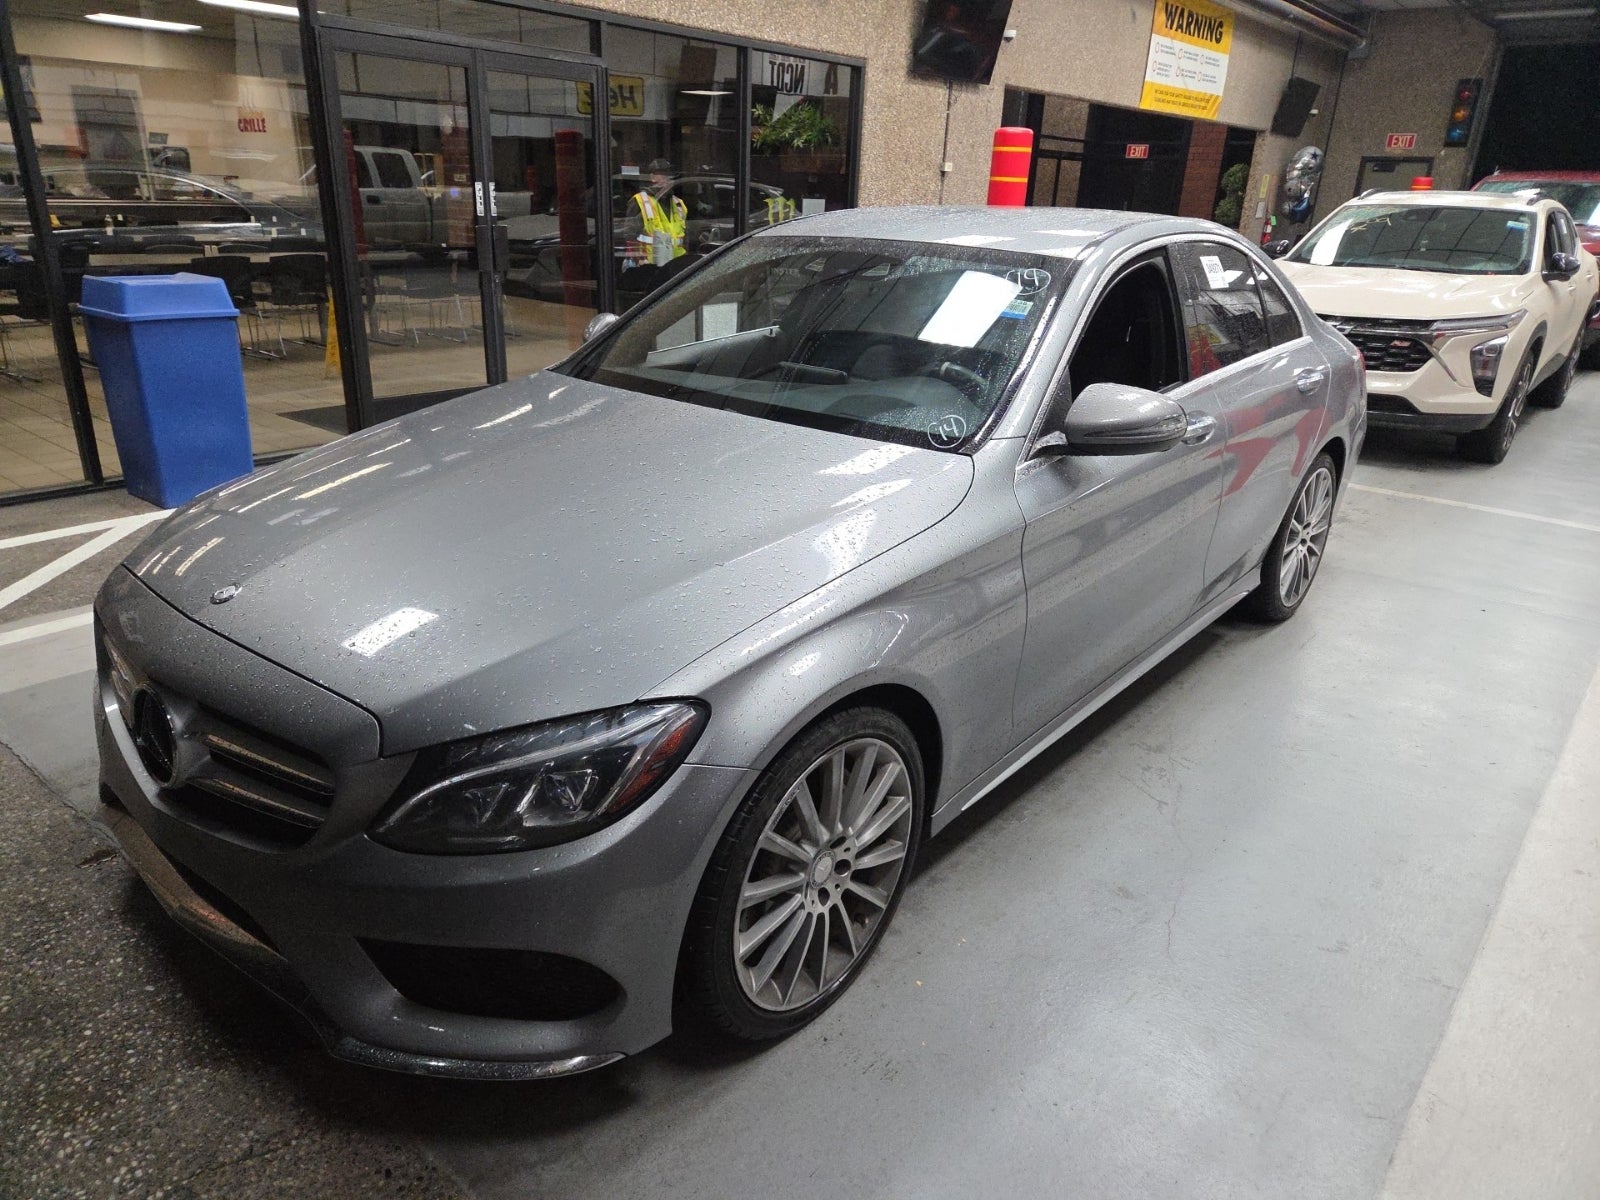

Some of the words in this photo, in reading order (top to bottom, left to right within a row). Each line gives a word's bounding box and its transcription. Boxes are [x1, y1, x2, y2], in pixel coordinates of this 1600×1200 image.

[1164, 1, 1224, 45] WARNING
[238, 118, 267, 132] GRILLE
[1391, 135, 1413, 148] EXIT
[1130, 146, 1146, 157] EXIT
[939, 418, 959, 441] 14
